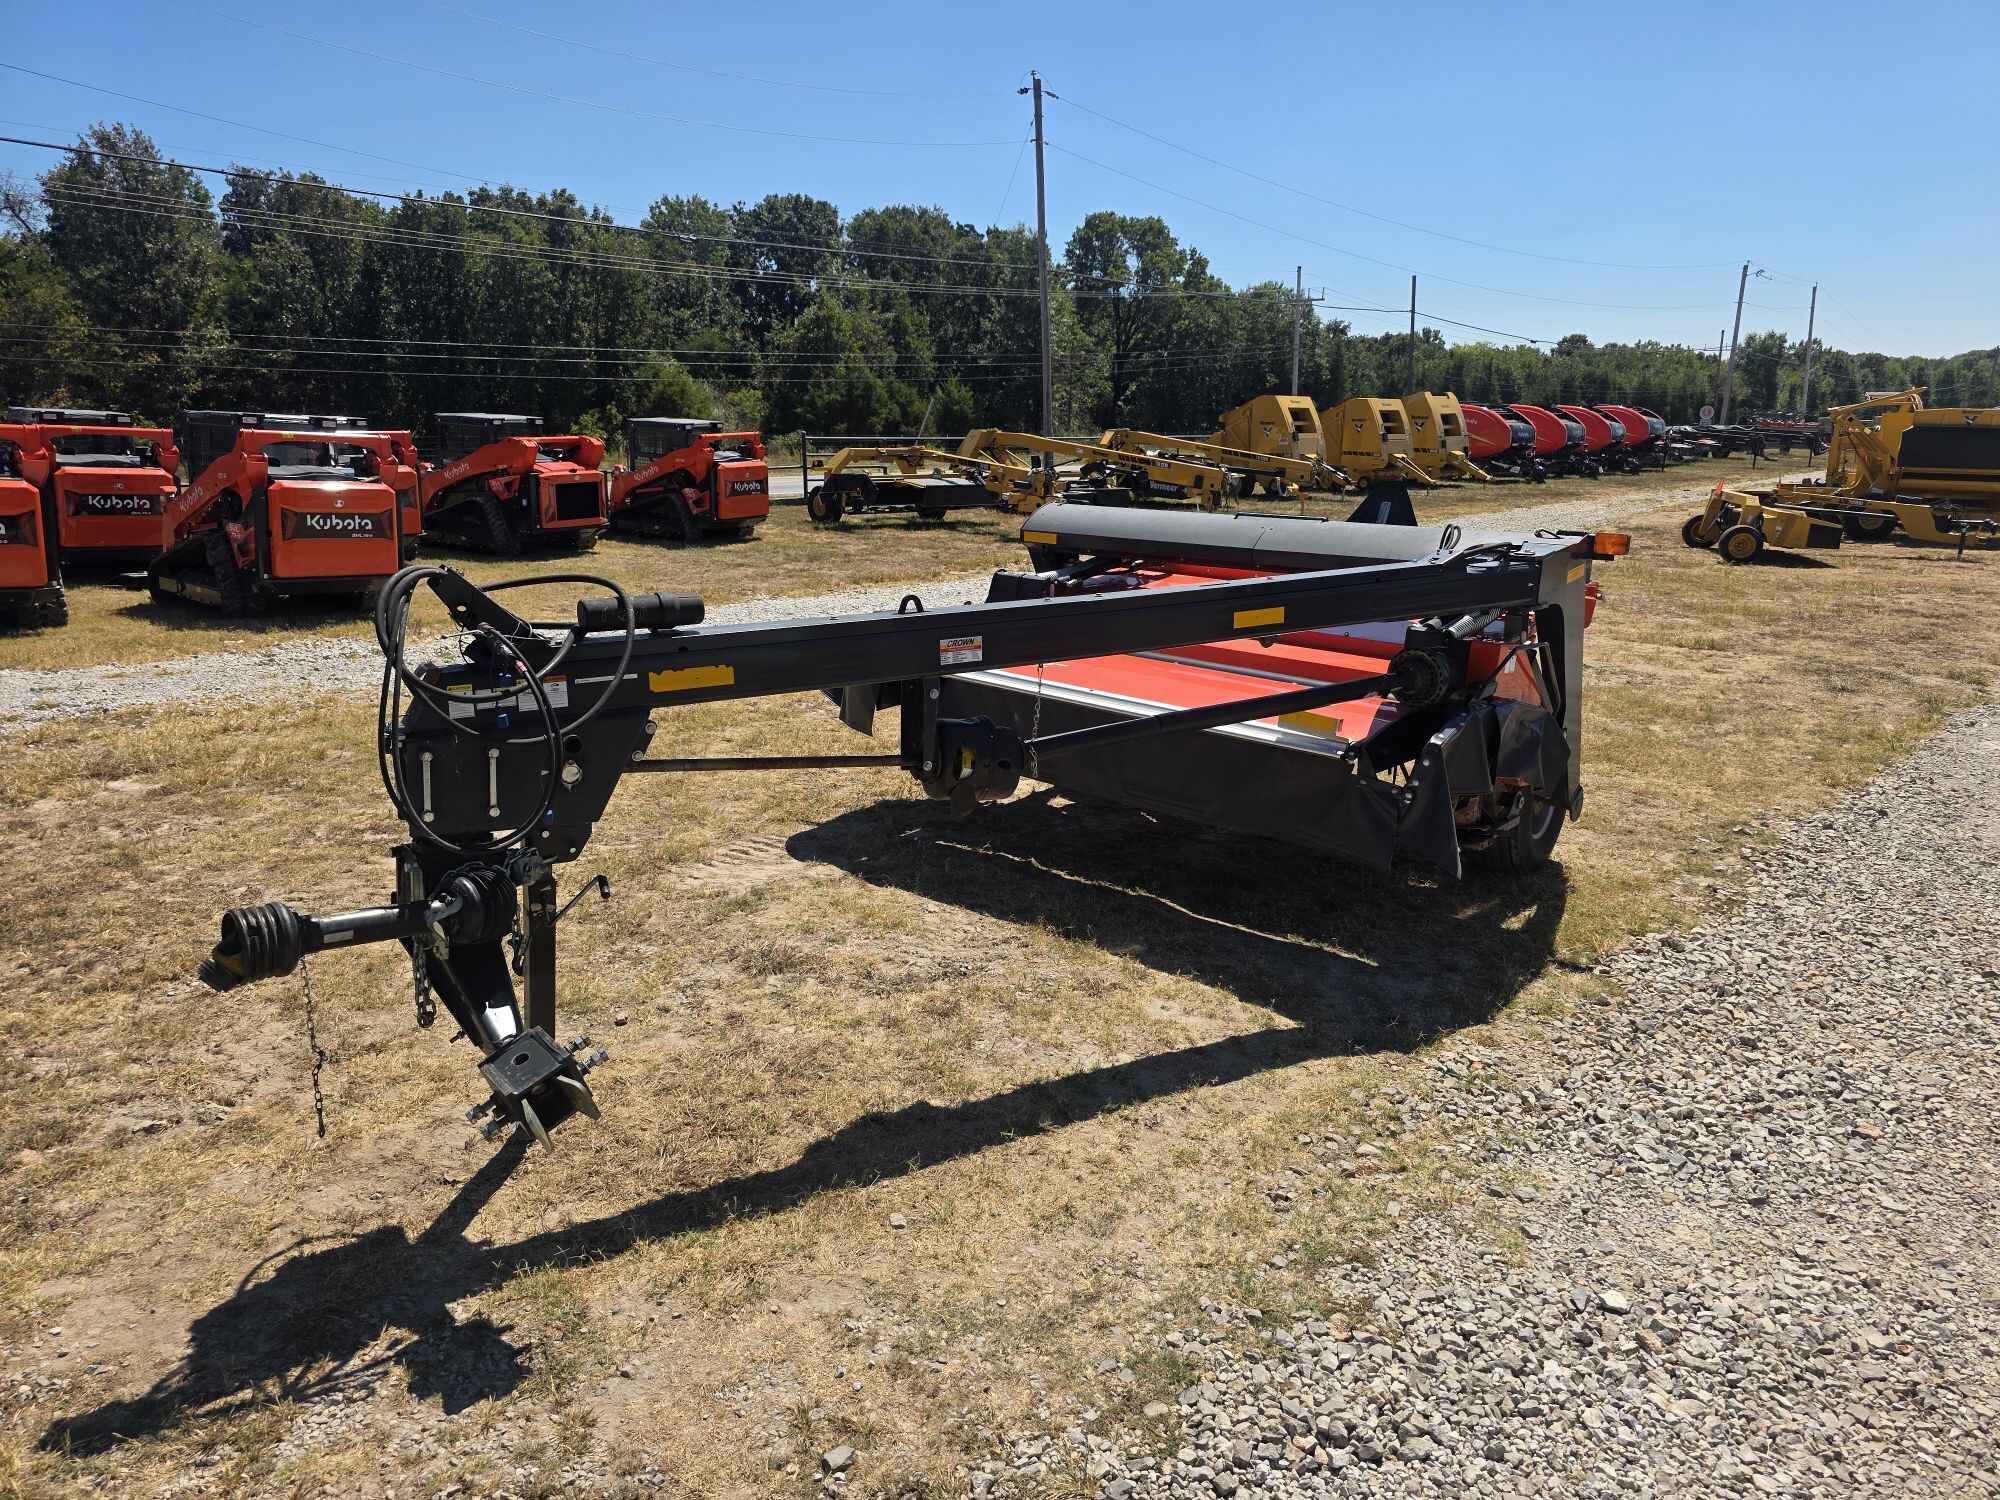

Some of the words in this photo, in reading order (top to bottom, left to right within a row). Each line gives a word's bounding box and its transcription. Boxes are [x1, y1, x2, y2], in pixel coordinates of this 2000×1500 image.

[734, 482, 761, 491] Kubota
[88, 495, 151, 509] Kubota
[306, 514, 373, 530] Kubota
[947, 638, 975, 647] CROWN
